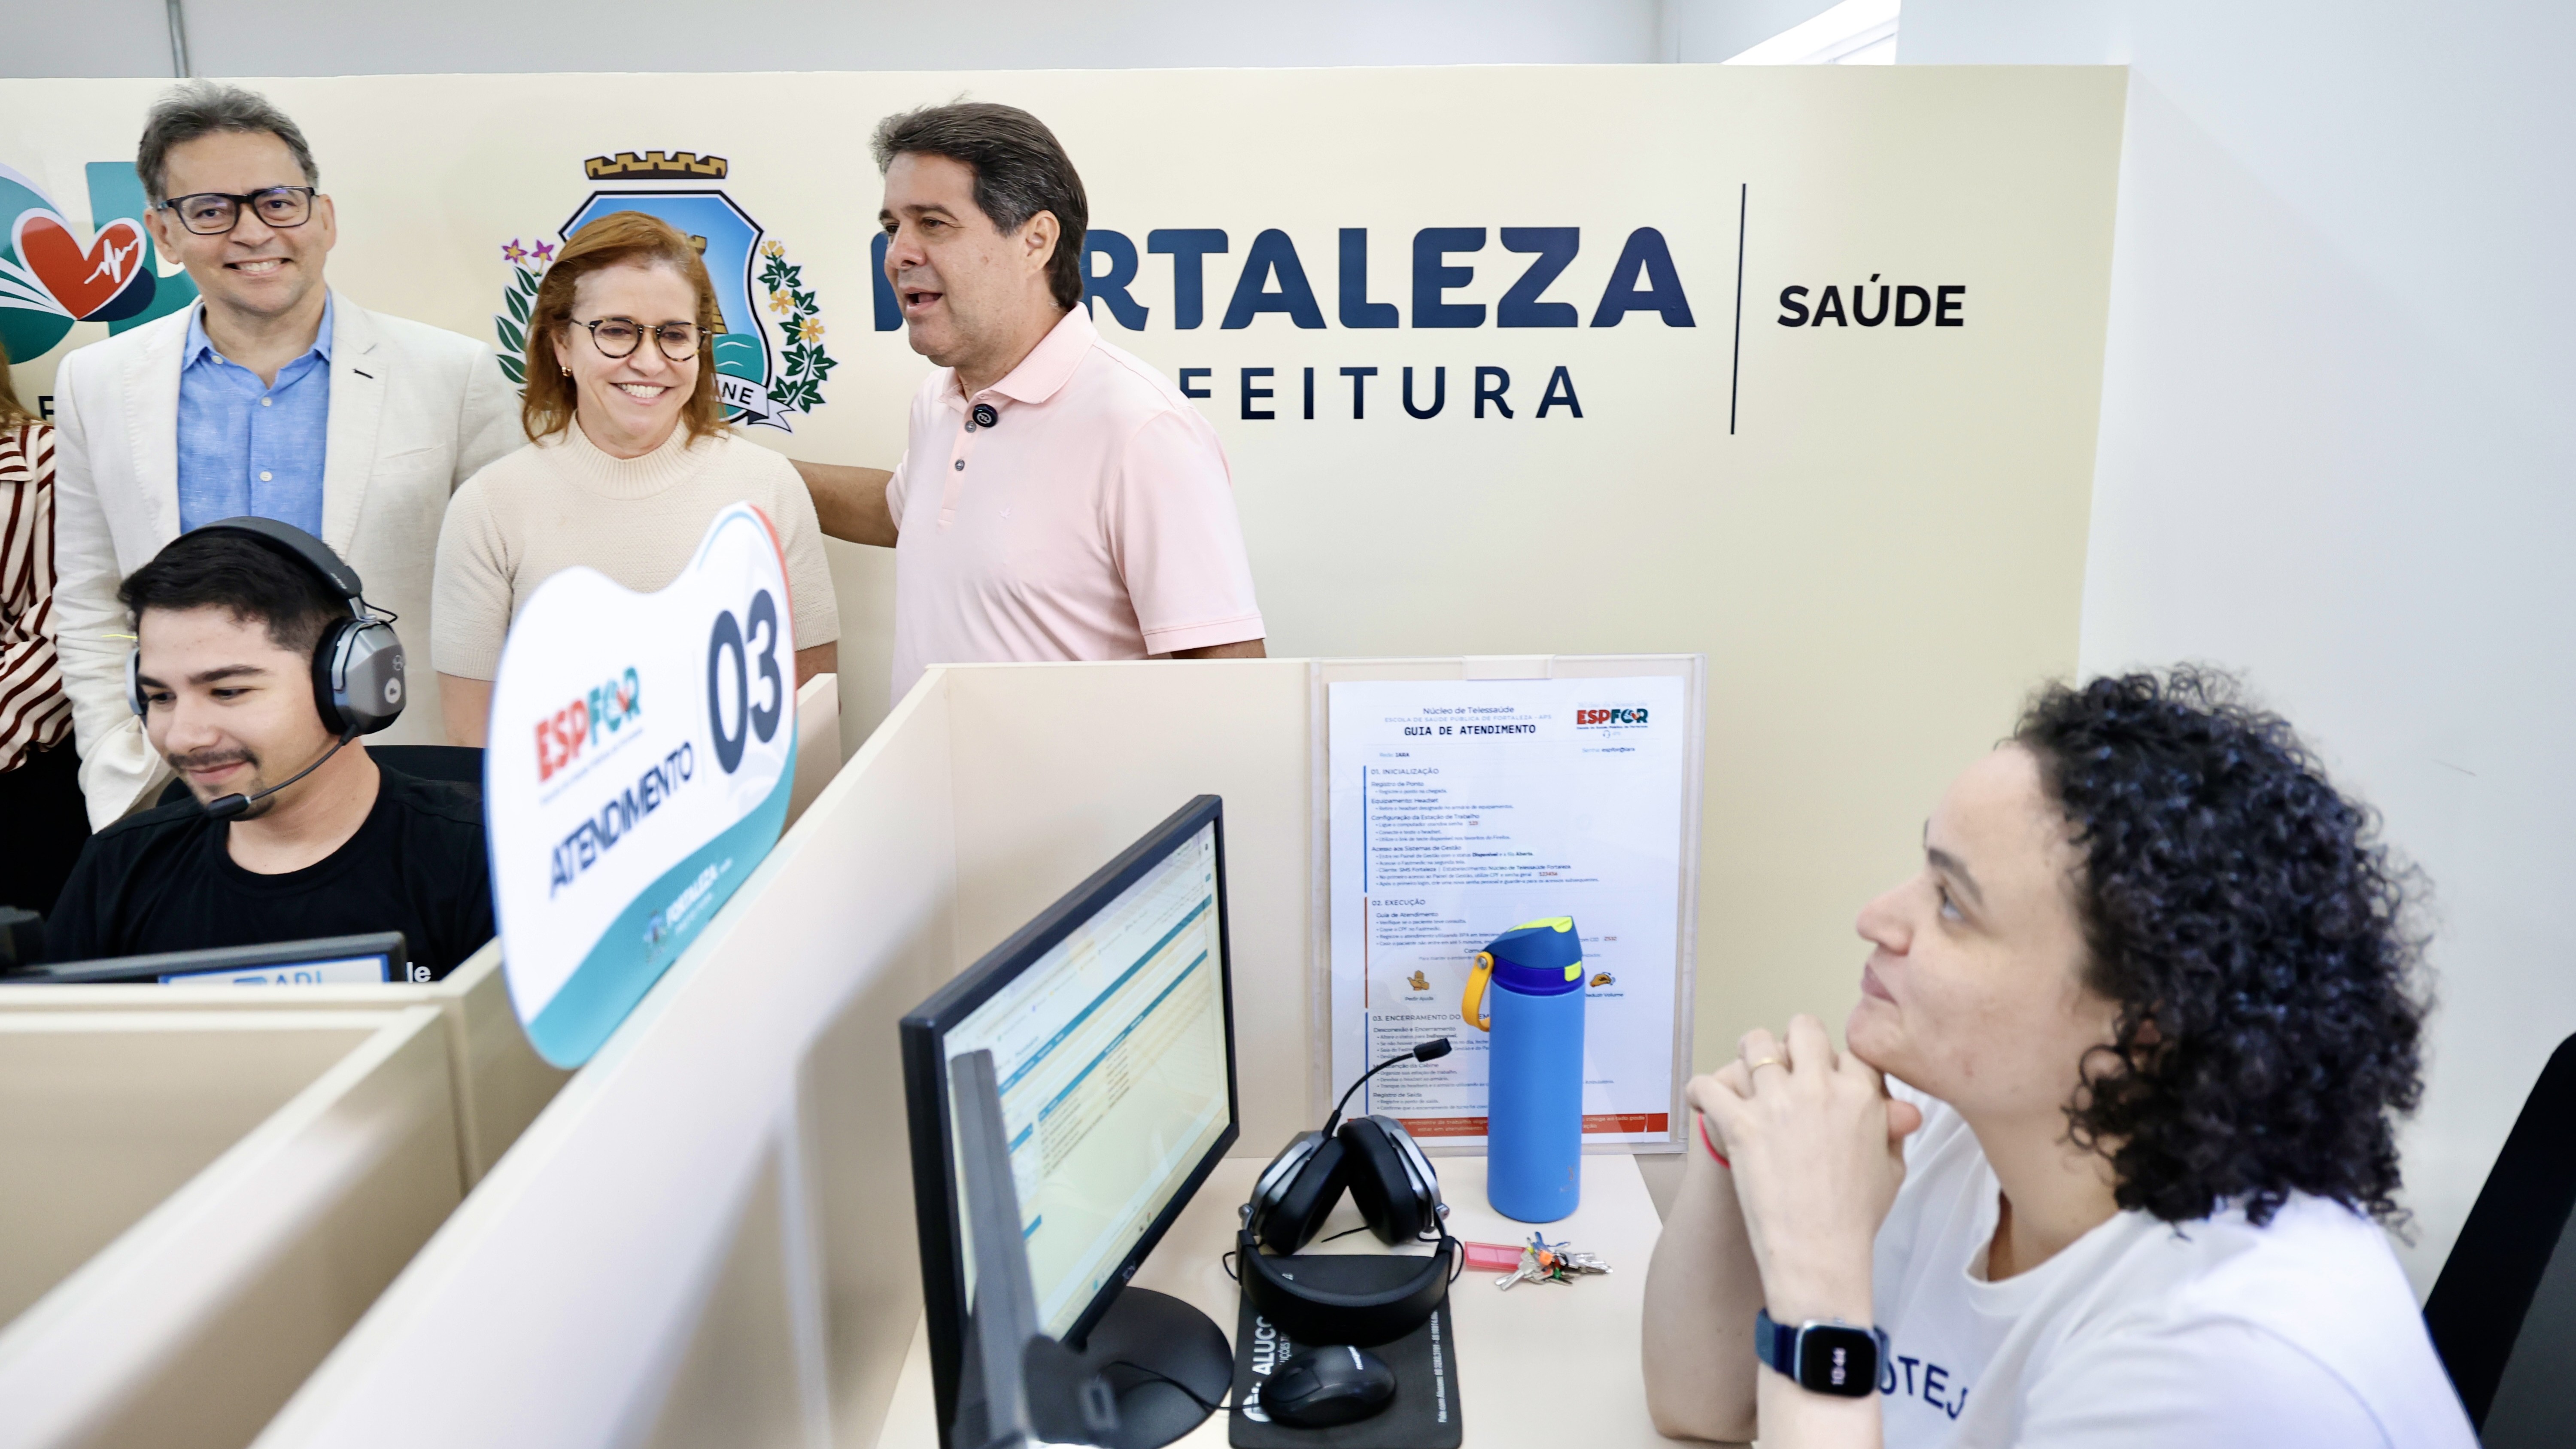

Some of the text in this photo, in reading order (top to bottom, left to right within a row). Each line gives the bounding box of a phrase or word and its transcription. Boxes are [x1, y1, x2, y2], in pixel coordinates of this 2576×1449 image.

[871, 226, 1696, 331] RTALEZA
[1777, 273, 1966, 327] SAÚDE
[1179, 366, 1583, 420] FEITURA
[707, 588, 782, 774] 03
[1404, 724, 1536, 735] GUIA DE ATENDIMENTO
[1577, 708, 1648, 724] ESPFOR
[1382, 767, 1439, 776] INICIALIZAÇÃO
[549, 741, 696, 900] ATENDIMENTO
[1385, 898, 1426, 907] EXECUÇÃO
